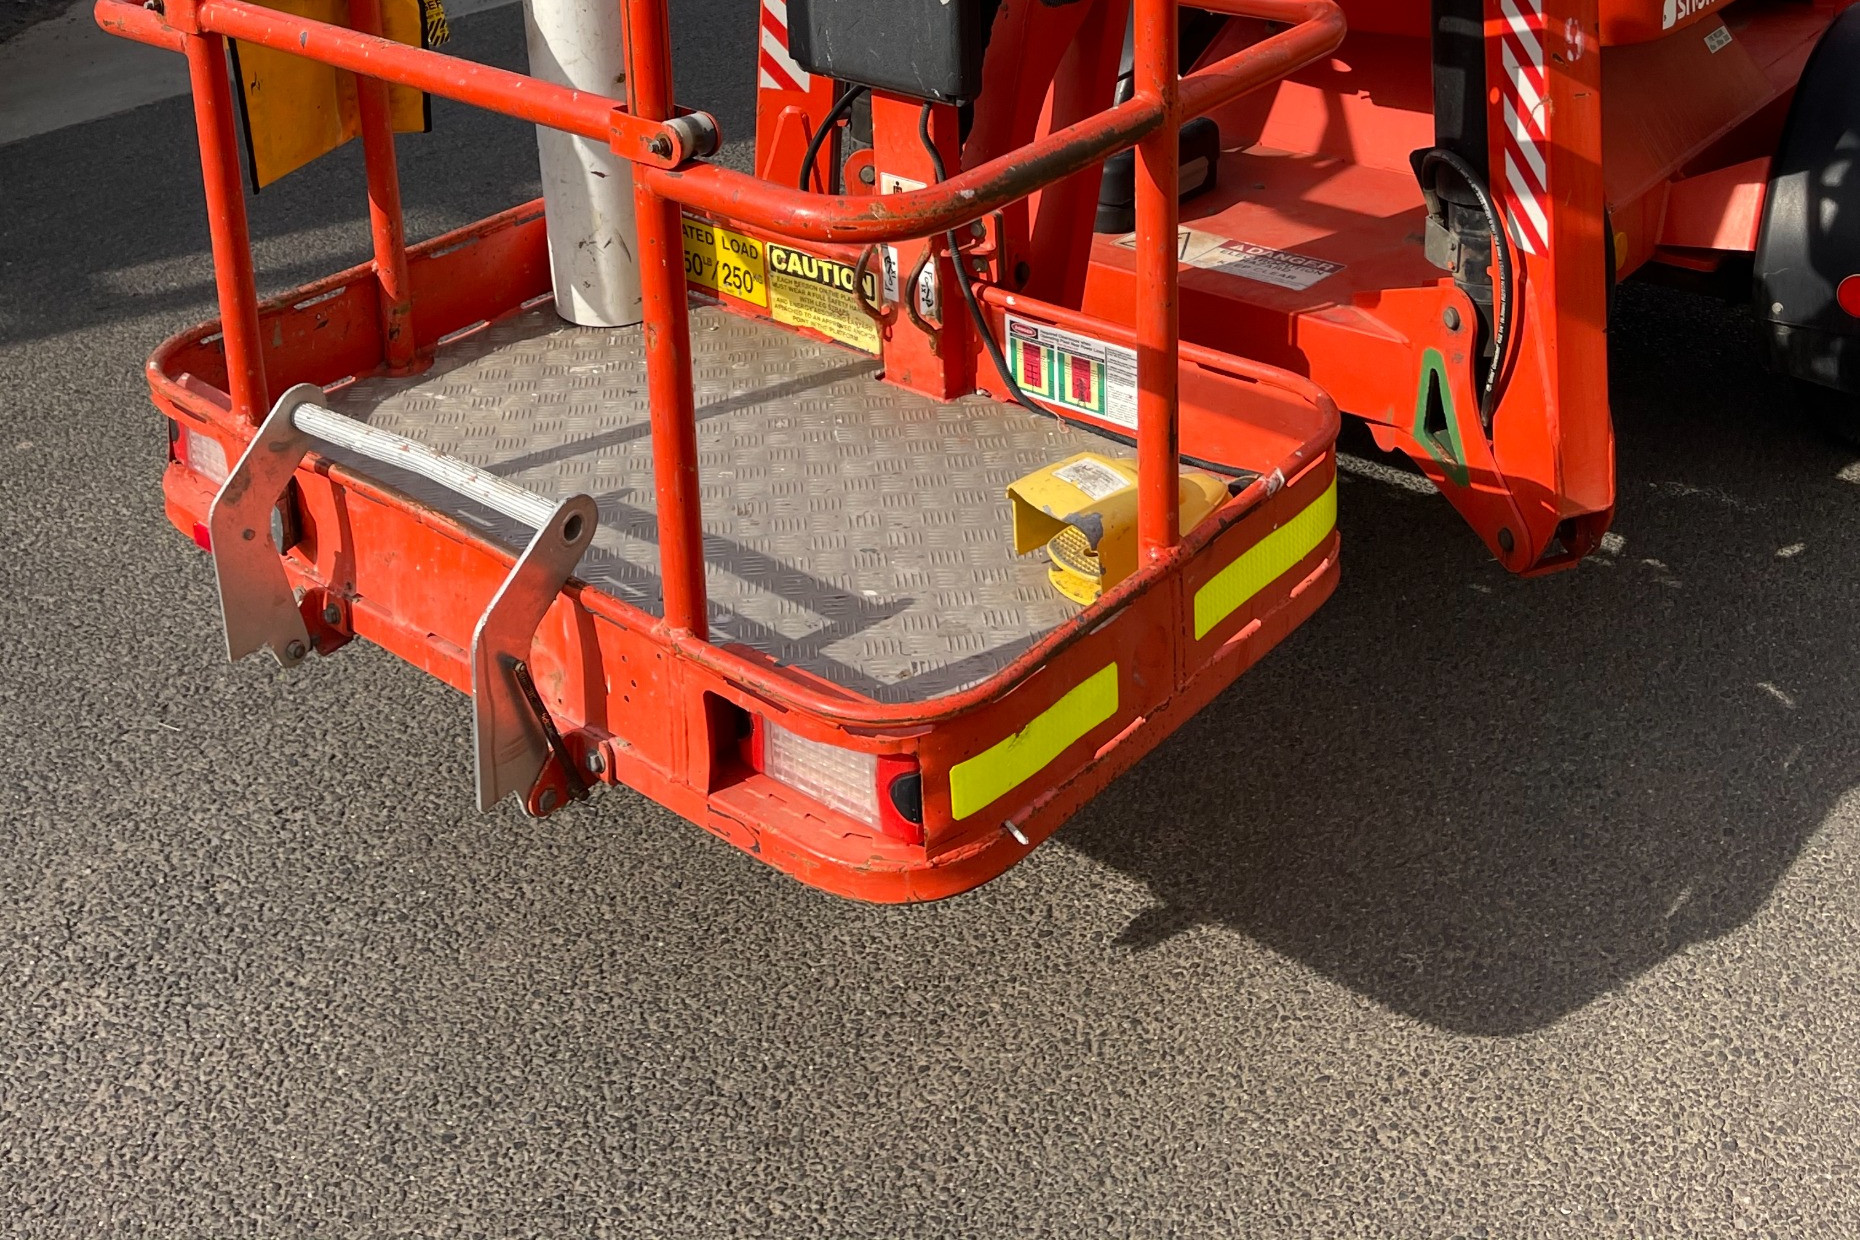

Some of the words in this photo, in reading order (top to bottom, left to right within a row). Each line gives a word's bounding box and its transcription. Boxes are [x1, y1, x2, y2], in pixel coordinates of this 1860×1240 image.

[682, 223, 715, 246] ATED
[722, 236, 758, 260] LOAD
[1246, 247, 1335, 271] DANGER
[770, 249, 873, 298] CAUTION
[1253, 267, 1297, 280] CLEAR
[772, 281, 788, 292] MUST
[789, 285, 806, 297] WEAR
[812, 291, 827, 302] FULL
[828, 295, 849, 309] SAFETY
[800, 296, 814, 305] WITH
[815, 300, 827, 309] LEG
